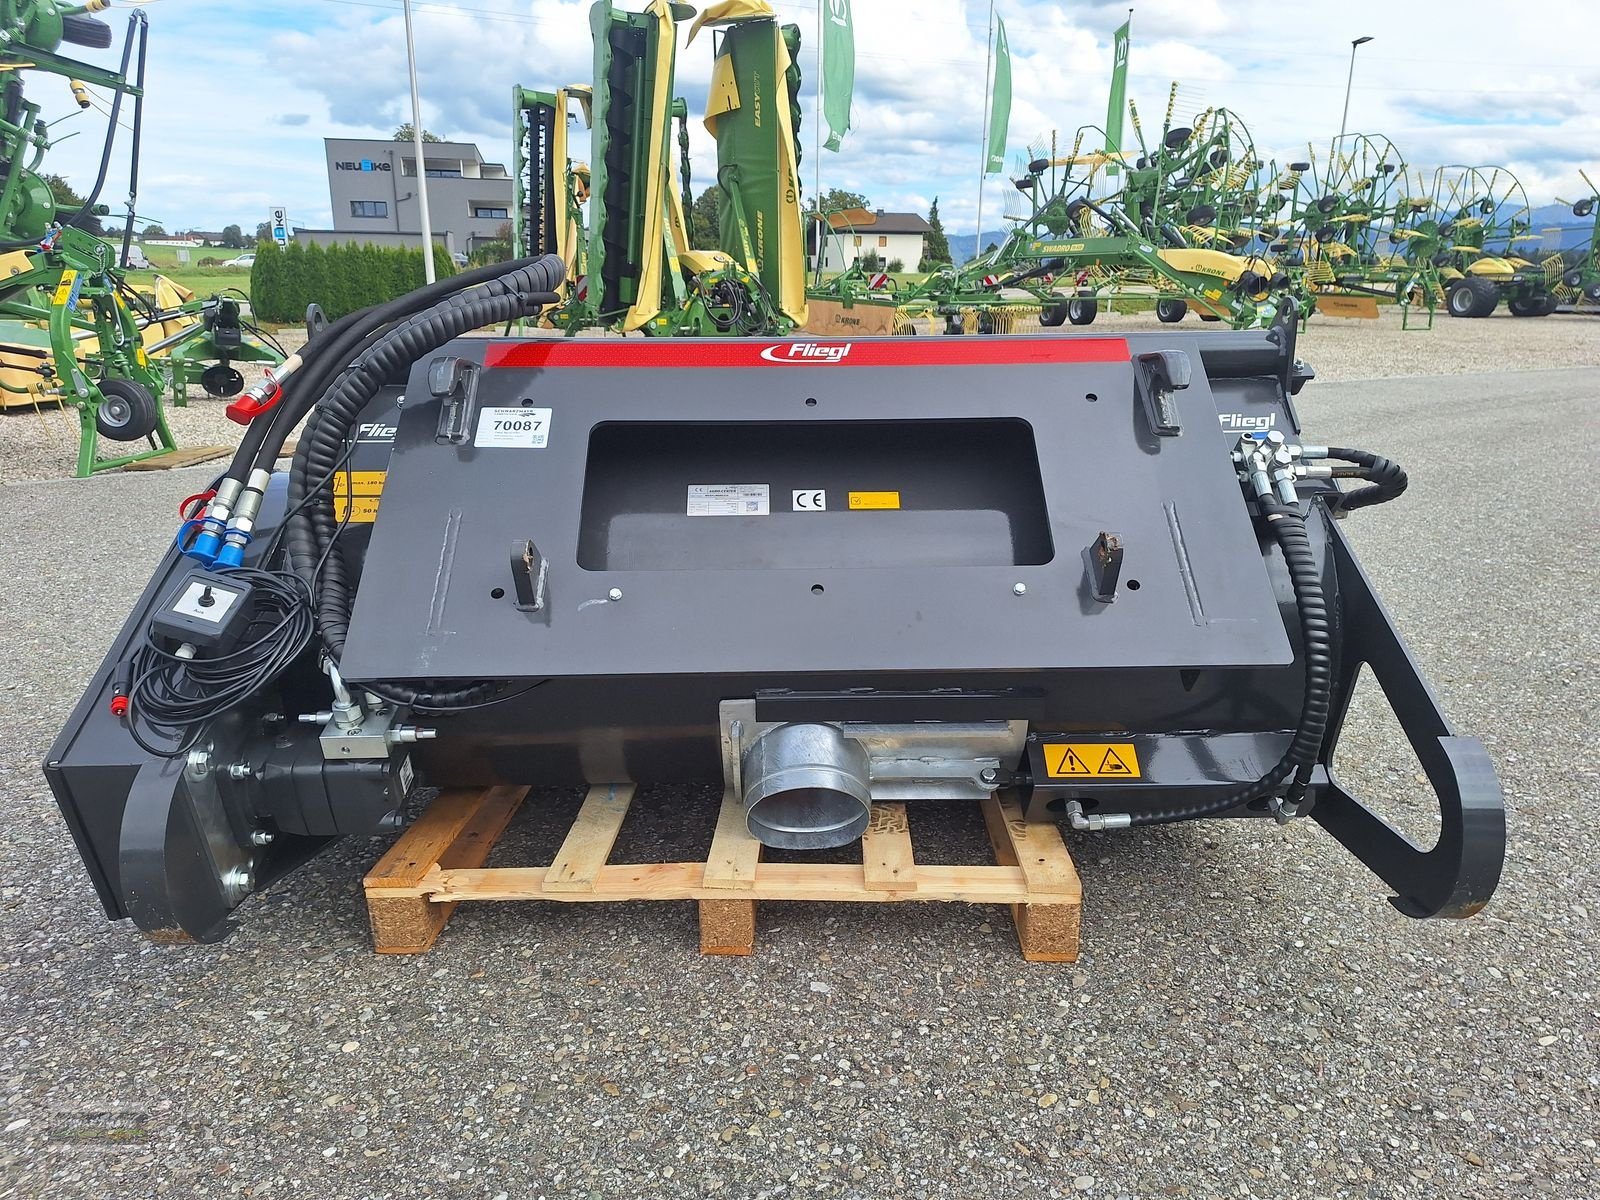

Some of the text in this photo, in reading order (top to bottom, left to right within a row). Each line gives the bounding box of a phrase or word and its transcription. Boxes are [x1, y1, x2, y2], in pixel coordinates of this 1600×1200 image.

[788, 343, 851, 360] Fliegl
[493, 420, 543, 431] 70087
[1218, 412, 1276, 430] Fliegl
[360, 423, 398, 440] Flie
[796, 492, 822, 508] CE
